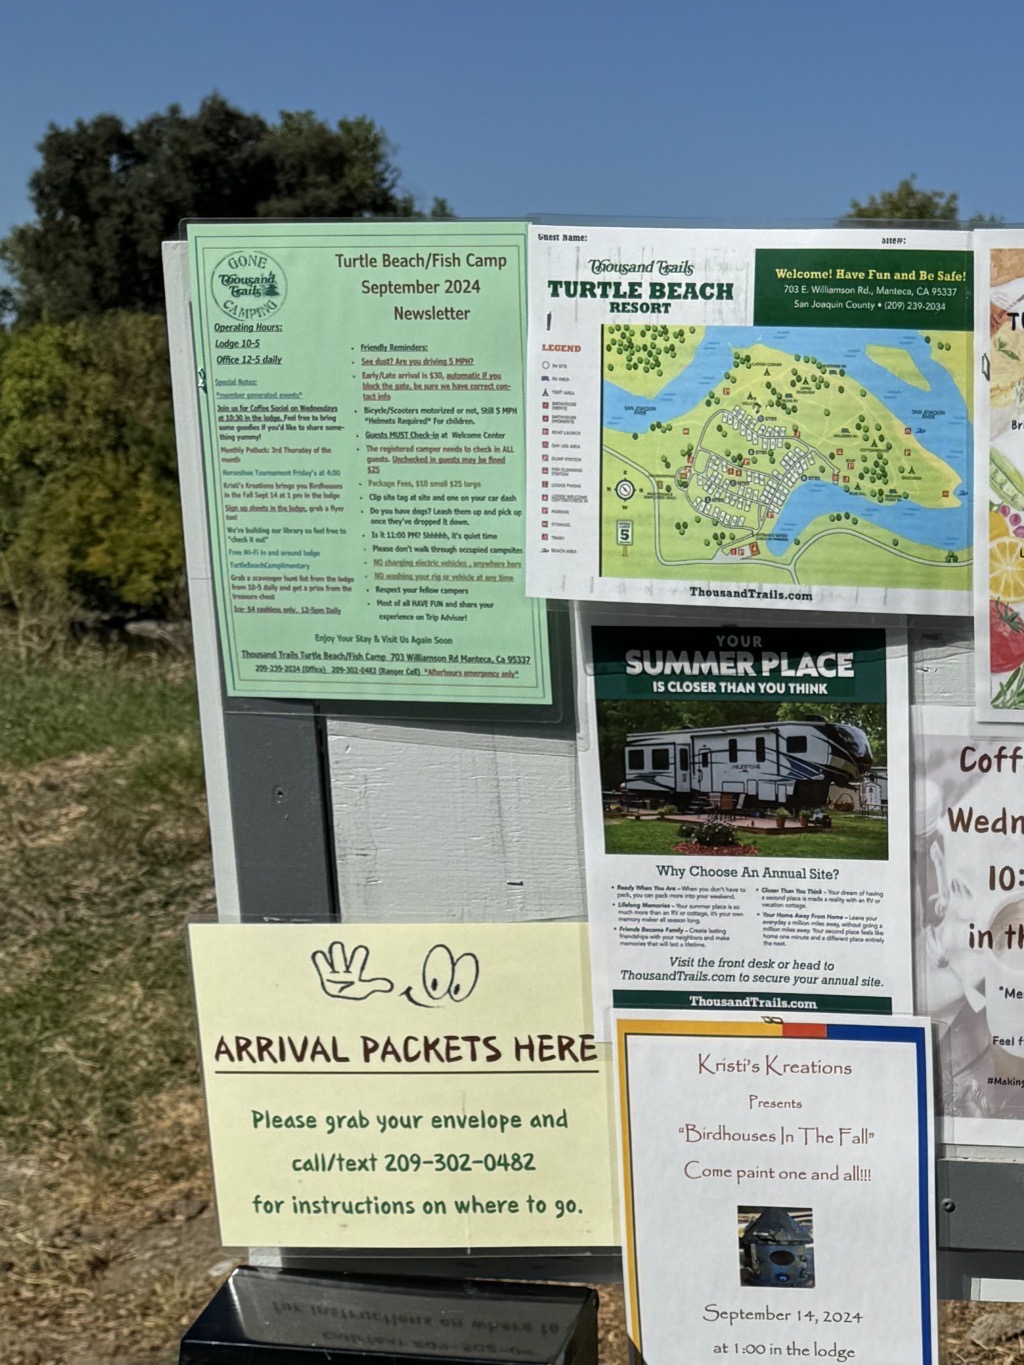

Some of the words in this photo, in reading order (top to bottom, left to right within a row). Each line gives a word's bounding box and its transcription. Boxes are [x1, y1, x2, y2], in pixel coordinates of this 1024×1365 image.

[228, 254, 266, 270] GONE
[335, 254, 377, 268] Turtle
[382, 253, 462, 269] Beach/Fish
[466, 253, 507, 269] Camp
[588, 260, 654, 274] Thousand
[657, 261, 694, 276] Trails
[219, 273, 275, 285] Thousand
[776, 269, 832, 280] Welcome!
[836, 269, 864, 280] Have
[869, 269, 891, 281] Fun
[894, 270, 915, 281] and
[919, 270, 934, 281] Be
[938, 270, 966, 282] Safe!
[229, 284, 261, 297] Trails
[362, 281, 439, 297] September
[445, 279, 480, 294] 2024
[548, 281, 645, 299] TURTLE
[650, 282, 733, 300] BEACH
[784, 285, 798, 294] 703
[802, 285, 809, 294] E.
[811, 285, 855, 295] Williamson
[876, 286, 913, 297] Manteca,
[916, 287, 929, 296] CA
[931, 287, 957, 296] 95337
[223, 299, 277, 320] CAMPING
[394, 306, 470, 320] Newsletter
[610, 302, 671, 314] RESORT
[794, 300, 809, 308] San
[812, 300, 842, 311] Joaquin
[845, 301, 875, 312] County
[884, 301, 904, 312] (209)
[906, 301, 946, 311] 239-2034
[214, 323, 253, 333] Operating
[256, 323, 282, 332] Hours:
[215, 339, 239, 349] Lodge
[241, 339, 260, 348] 10-5
[361, 343, 387, 352] Friendly
[390, 343, 427, 351] Reminders:
[542, 344, 581, 352] LEGEND
[217, 355, 239, 364] Office
[242, 355, 260, 363] 12-5
[263, 355, 282, 365] daily
[423, 358, 447, 366] driving
[376, 586, 401, 595] Respect
[419, 586, 438, 594] fellow
[440, 588, 468, 596] campers
[690, 587, 813, 601] ThousandTrails.com
[315, 634, 334, 645] Enjoy
[337, 634, 353, 643] Your
[355, 635, 372, 645] Stay
[374, 635, 379, 643] &
[382, 635, 397, 643] Visit
[400, 636, 408, 644] Us
[411, 636, 432, 646] Again
[716, 635, 762, 647] YOUR
[626, 651, 756, 676] SUMMER
[762, 652, 854, 678] PLACE
[653, 681, 665, 693] IS
[667, 682, 716, 693] CLOSER
[720, 682, 755, 693] THAN
[758, 683, 786, 694] YOU
[789, 684, 828, 694] THINK
[656, 865, 685, 878] Why
[689, 866, 738, 877] Choose
[742, 867, 760, 878] An
[763, 868, 806, 879] Annual
[809, 869, 839, 880] Site?
[969, 924, 992, 949] in
[690, 996, 817, 1009] ThousandTrails.com
[215, 1036, 349, 1064] ARRIVAL
[360, 1036, 501, 1063] PACKETS
[514, 1034, 597, 1062] HERE
[766, 1055, 852, 1076] Kreations
[749, 1095, 802, 1109] Presents
[252, 1110, 316, 1129] Please
[326, 1111, 369, 1134] grab
[377, 1114, 423, 1134] your
[431, 1111, 522, 1133] envelope
[530, 1110, 568, 1128] and
[781, 1126, 794, 1145] In
[798, 1127, 834, 1145] The
[292, 1153, 376, 1172] call/text
[385, 1153, 536, 1172] 209-302-0482
[702, 1304, 791, 1325] September
[797, 1309, 818, 1324] 14,
[823, 1310, 863, 1324] 2024
